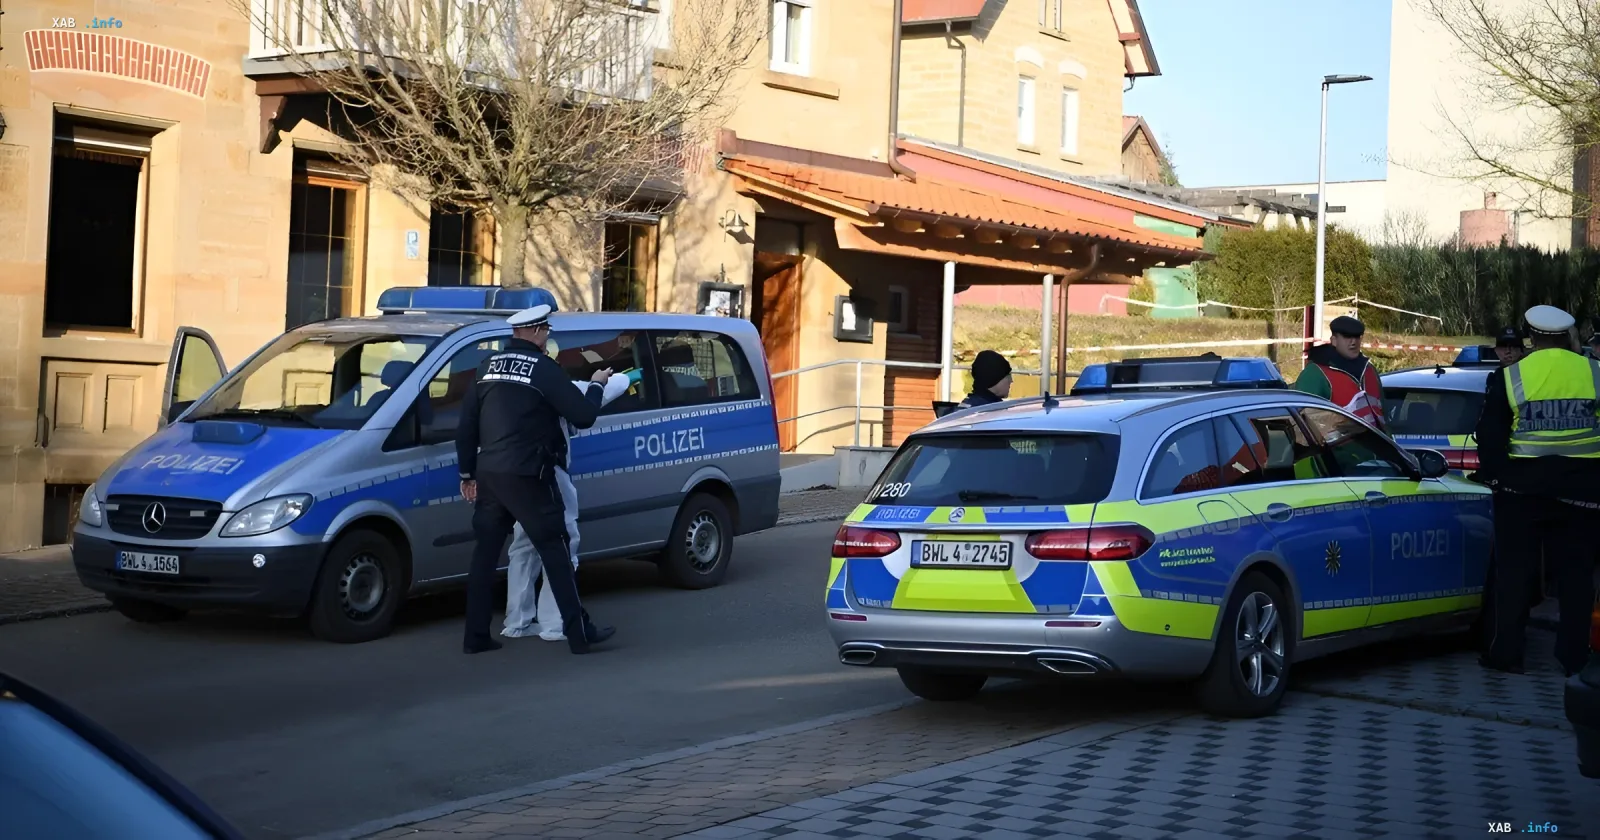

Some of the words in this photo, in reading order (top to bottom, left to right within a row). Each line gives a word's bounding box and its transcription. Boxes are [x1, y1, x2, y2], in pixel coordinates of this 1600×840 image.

[488, 360, 534, 377] POLIZEI
[634, 426, 705, 458] POLIZEI
[141, 454, 245, 475] POLIZEI
[922, 543, 949, 562] BWL
[953, 544, 960, 561] 4
[971, 544, 1008, 563] 2745
[1391, 528, 1450, 560] POLIZEI
